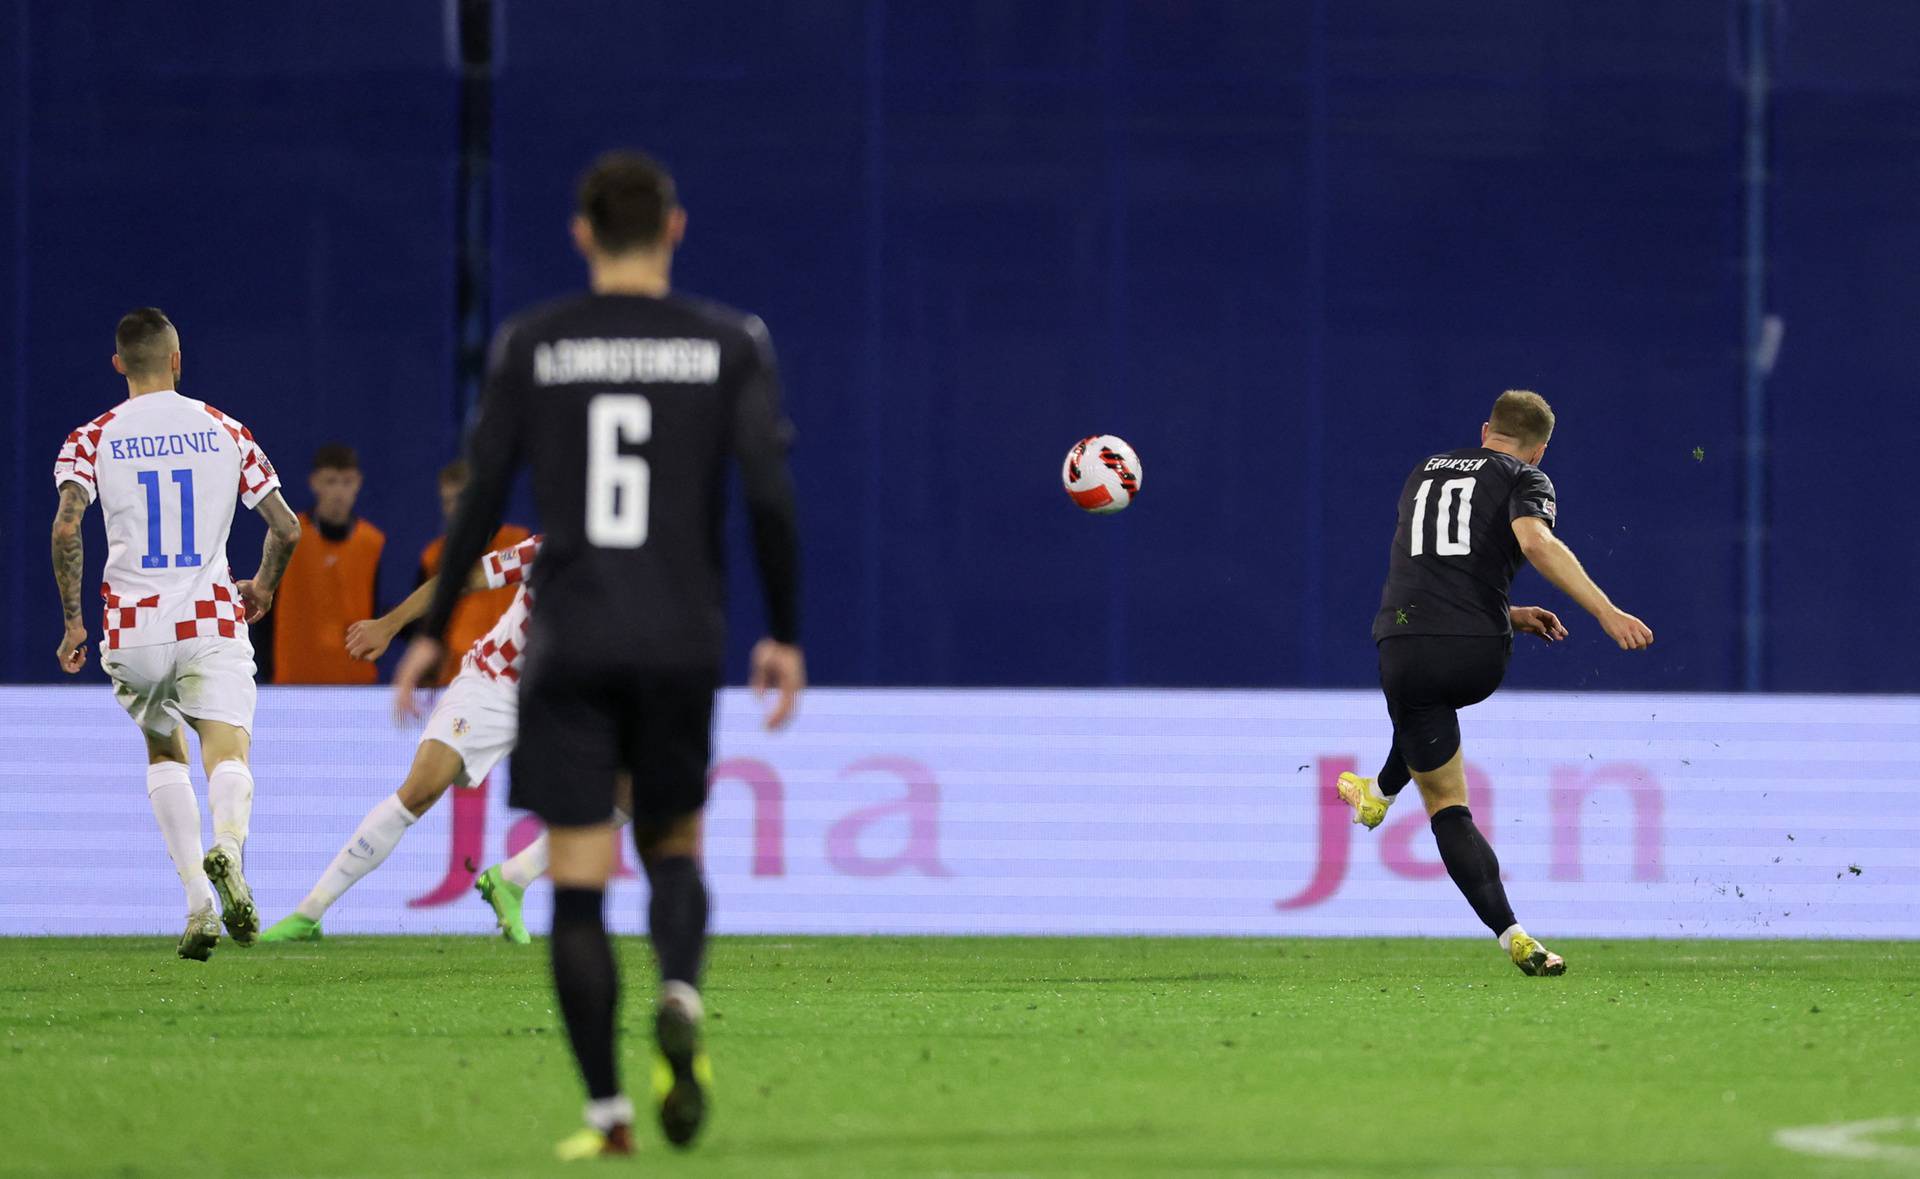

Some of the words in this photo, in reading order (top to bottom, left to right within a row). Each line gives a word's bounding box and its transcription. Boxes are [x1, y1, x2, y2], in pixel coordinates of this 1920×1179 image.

[110, 428, 219, 459] BROZOVIĆ
[585, 394, 652, 549] 6
[1424, 458, 1488, 471] ERIKSEN
[137, 469, 201, 569] 11
[1411, 477, 1476, 557] 10
